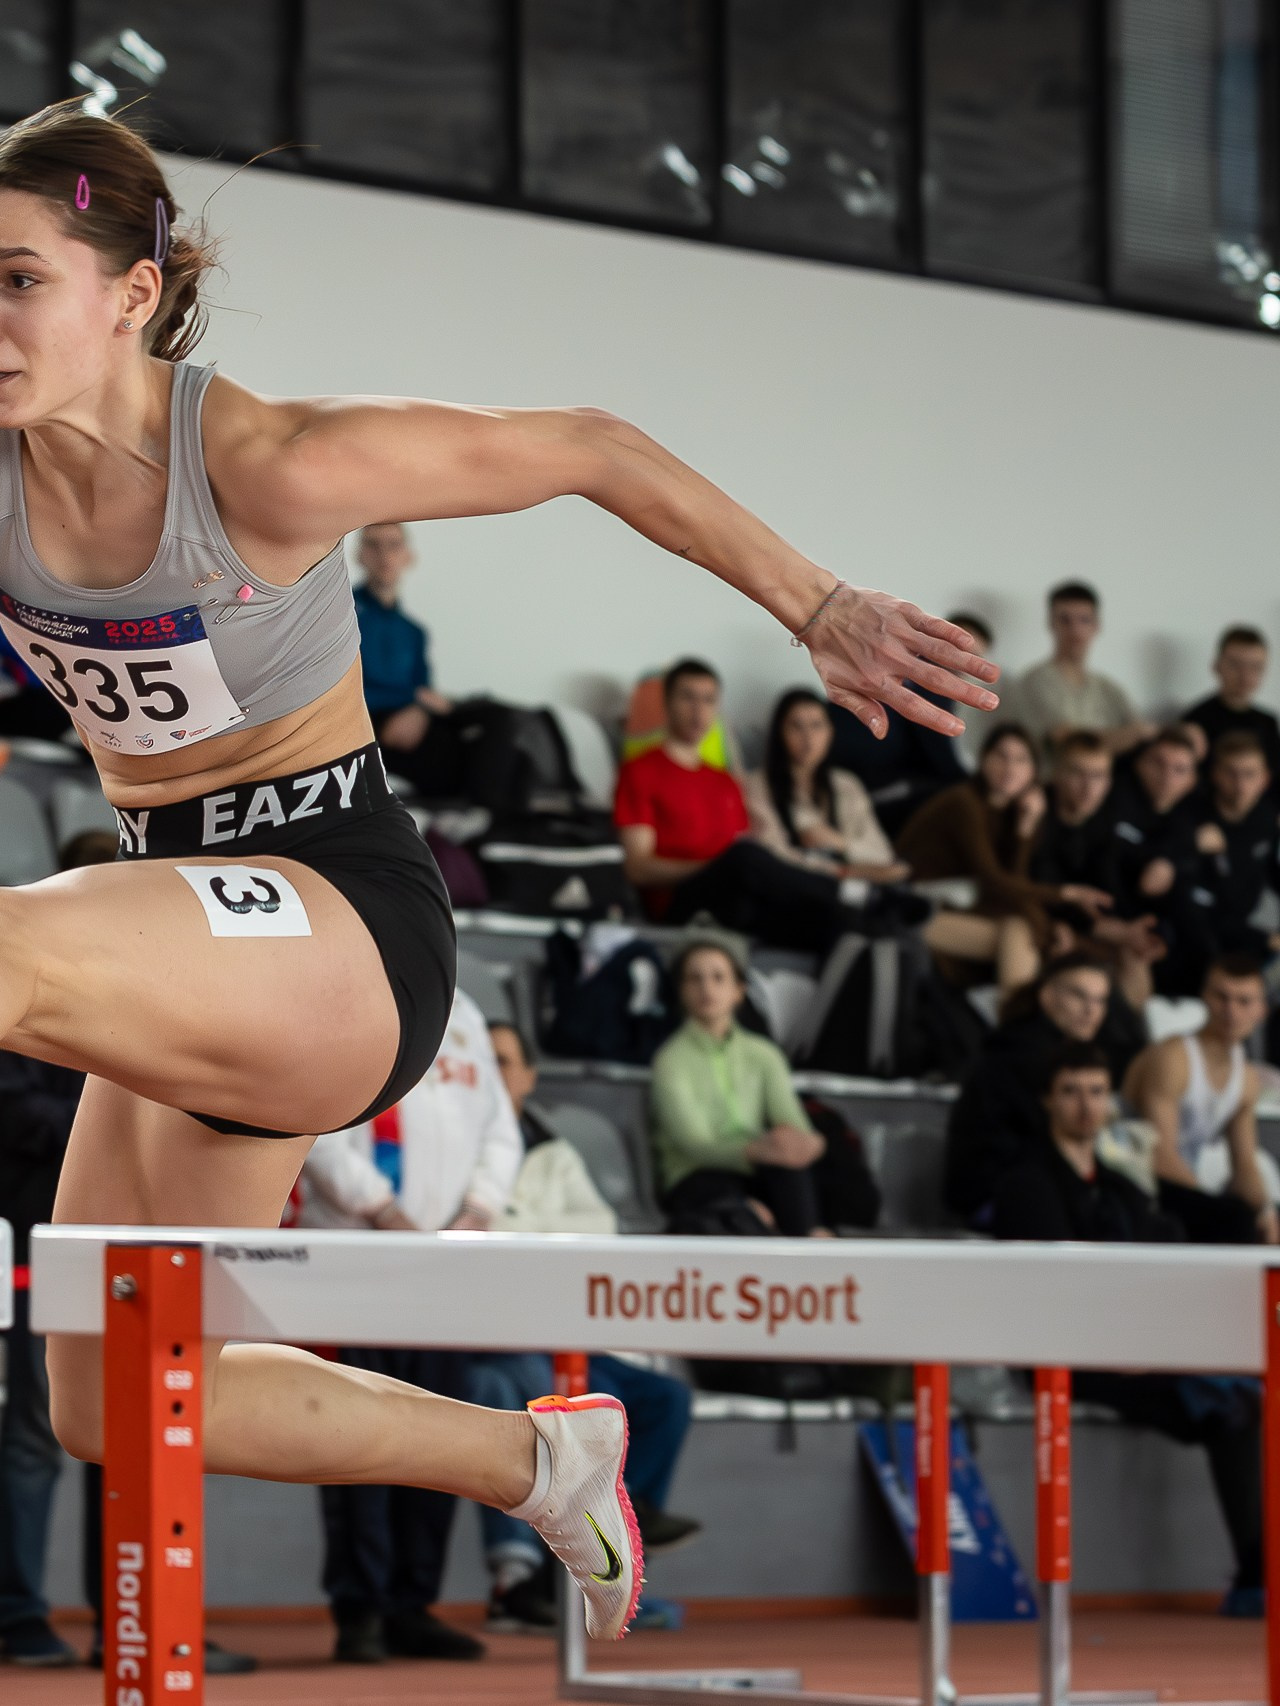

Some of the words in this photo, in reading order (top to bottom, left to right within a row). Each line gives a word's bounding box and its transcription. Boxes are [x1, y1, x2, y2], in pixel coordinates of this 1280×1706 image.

[104, 615, 177, 639] 2025
[28, 642, 190, 723] 335
[202, 754, 366, 846] EAZY
[209, 875, 282, 915] 3
[586, 1267, 725, 1323] nordic
[735, 1273, 860, 1337] Sport
[116, 1541, 148, 1681] nordic
